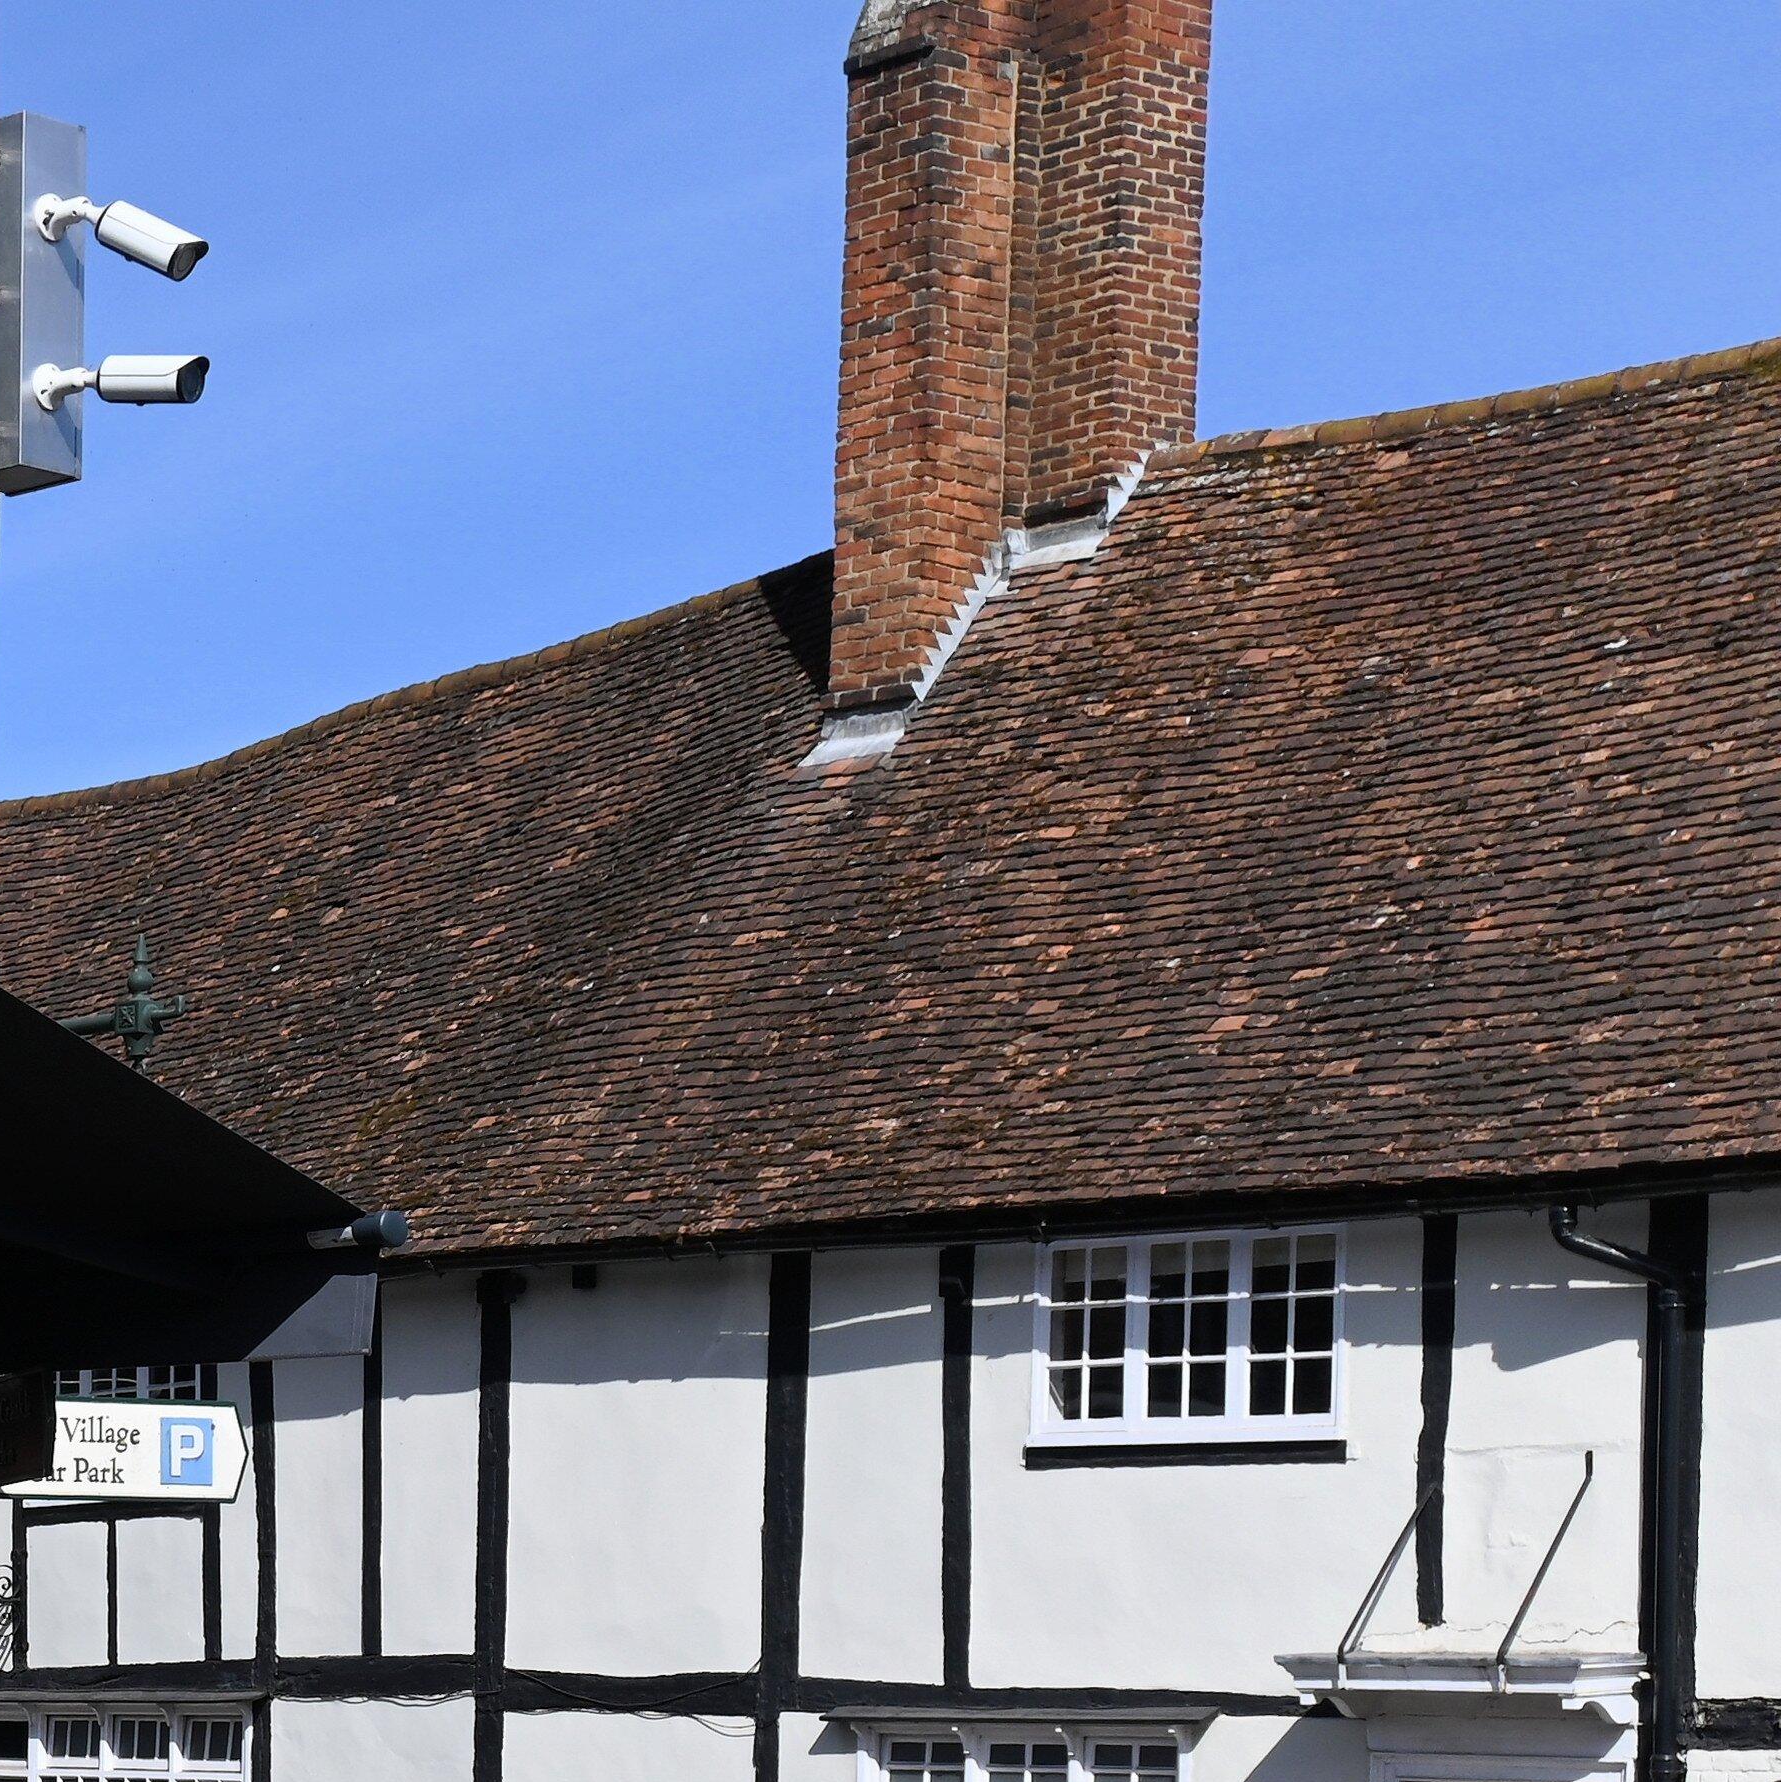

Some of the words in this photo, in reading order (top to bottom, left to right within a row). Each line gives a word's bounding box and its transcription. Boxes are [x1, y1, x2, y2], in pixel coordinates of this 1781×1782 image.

[59, 1415, 141, 1453] Village
[169, 1423, 205, 1477] P
[72, 1456, 125, 1485] Park
